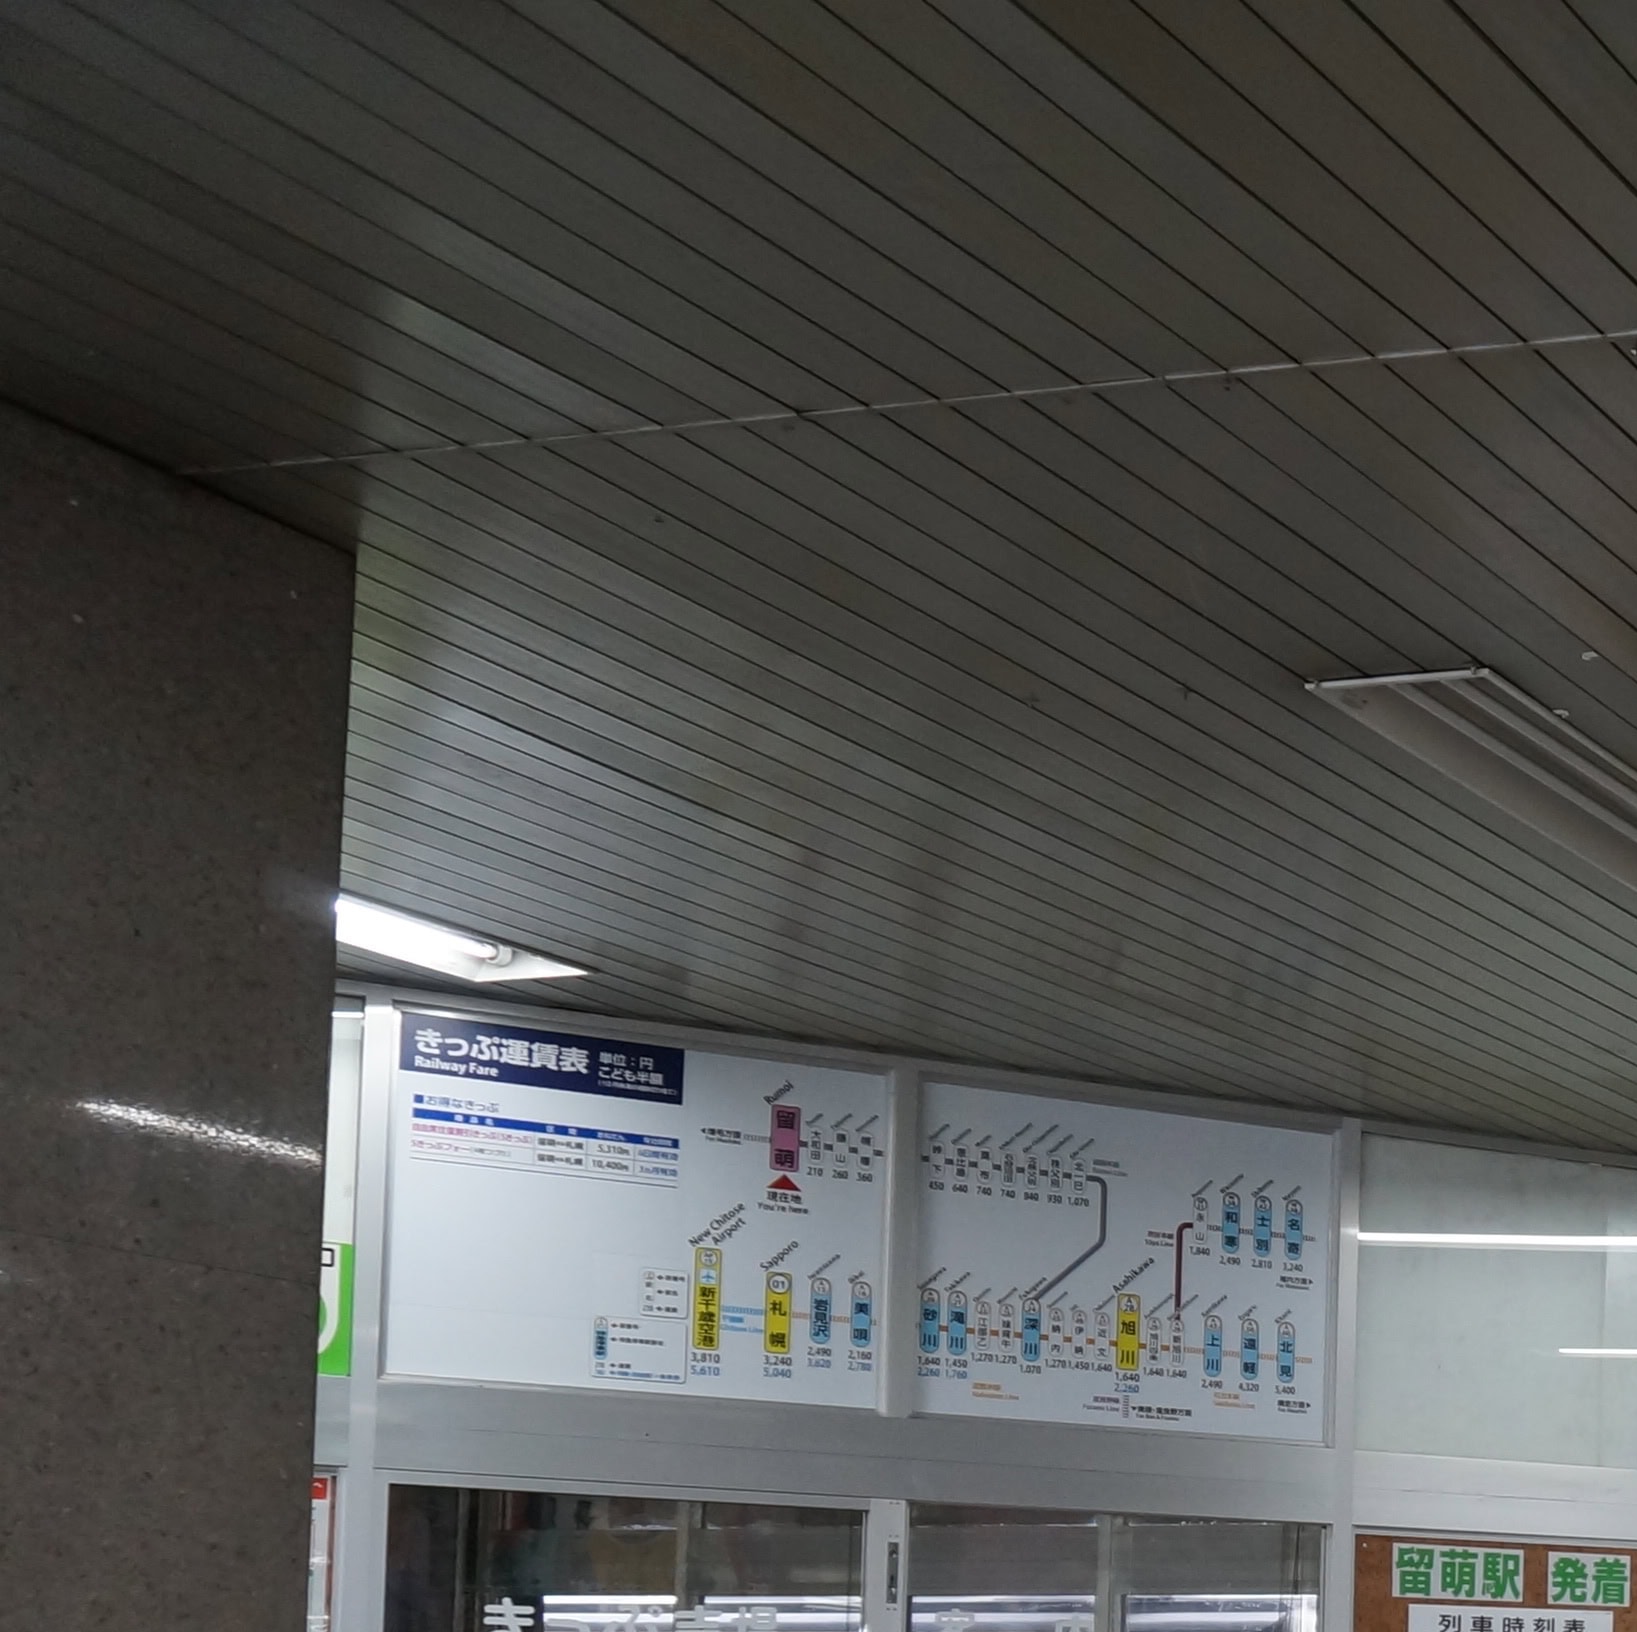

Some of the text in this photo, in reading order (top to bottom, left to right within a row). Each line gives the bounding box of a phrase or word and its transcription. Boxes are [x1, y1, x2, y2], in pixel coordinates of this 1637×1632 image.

[414, 1029, 590, 1074] きっぷ運賃表
[414, 1055, 499, 1078] Railway Fare
[763, 1080, 794, 1105] Rumoi
[757, 1202, 809, 1214] You're here
[766, 1191, 802, 1204] 現在地
[688, 1202, 746, 1248] New Chitose
[712, 1218, 747, 1246] Airport
[759, 1240, 800, 1272] Sapporo
[1112, 1256, 1156, 1293] Asahikawa
[697, 1287, 716, 1347] 新千歳空港
[769, 1300, 787, 1348] 札幌
[813, 1299, 830, 1338] 岩見沢
[690, 1352, 720, 1364] 3,810
[1120, 1320, 1136, 1365] 旭川
[1206, 1334, 1219, 1372] 上川
[1280, 1342, 1292, 1378] 北見
[763, 1355, 792, 1367] 3,240
[1115, 1372, 1140, 1383] 1,640
[1396, 1547, 1629, 1604] 留萌駅 発着
